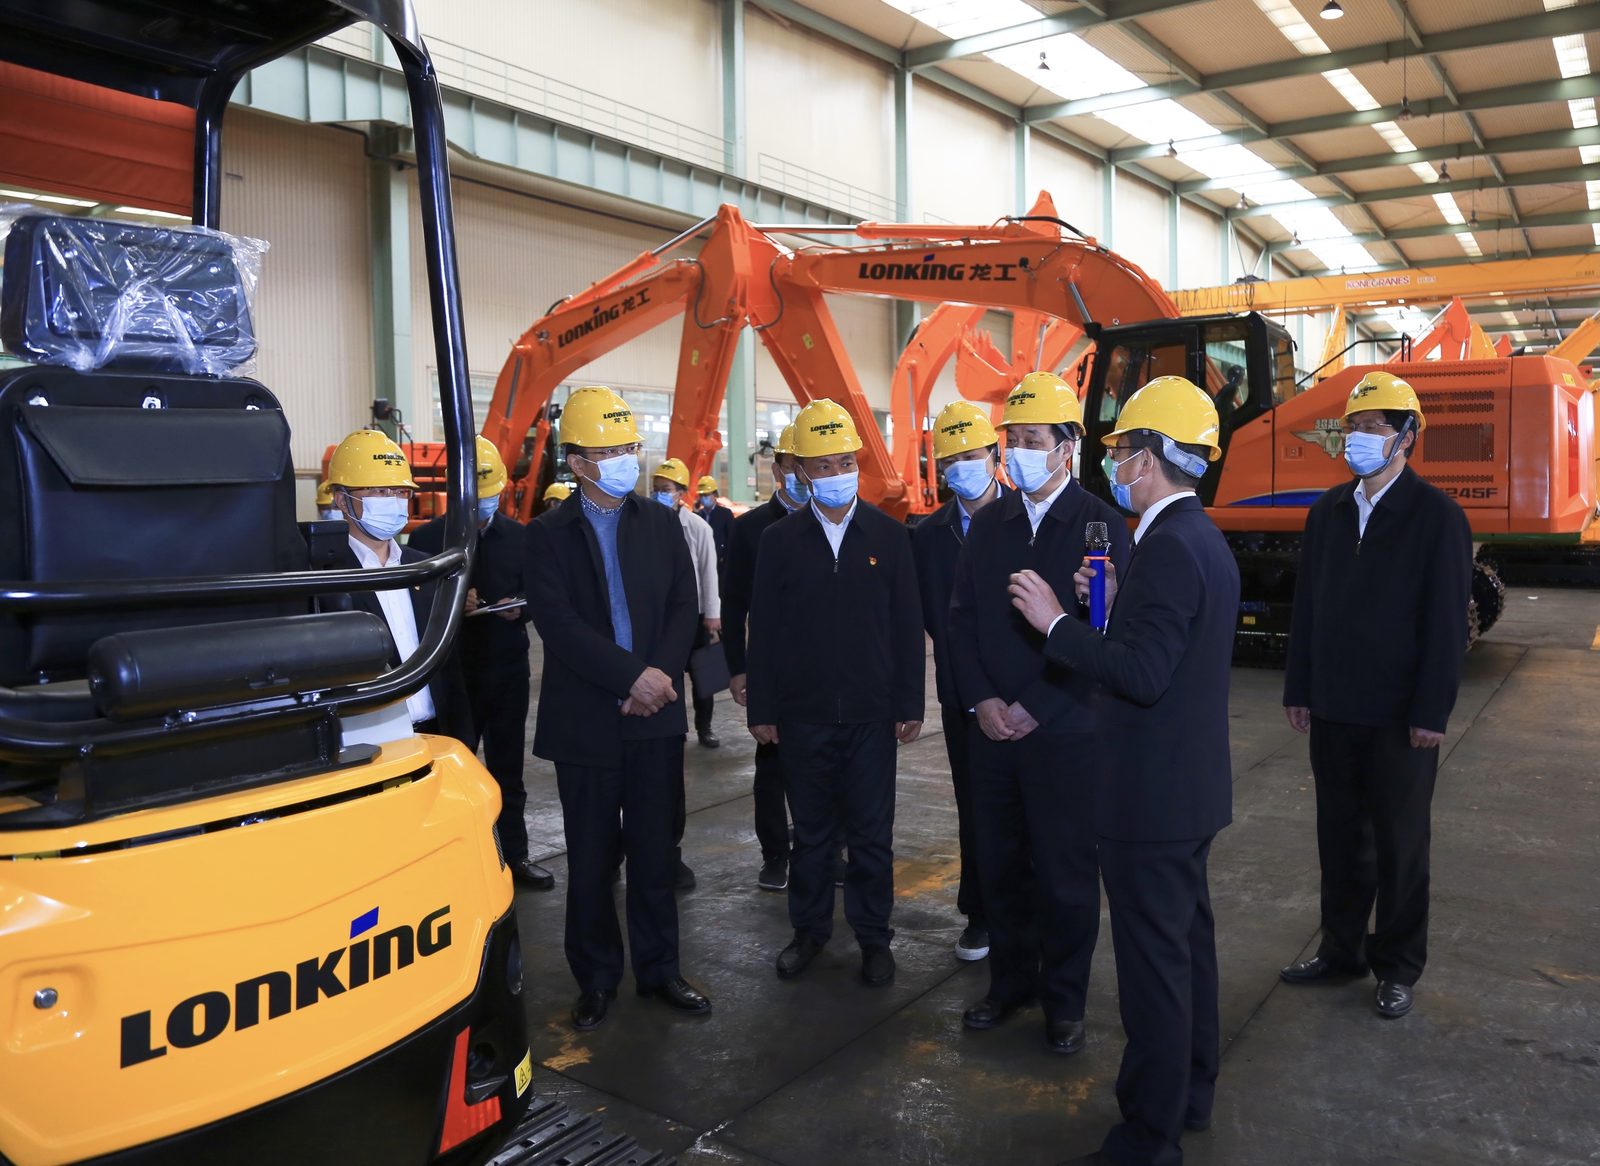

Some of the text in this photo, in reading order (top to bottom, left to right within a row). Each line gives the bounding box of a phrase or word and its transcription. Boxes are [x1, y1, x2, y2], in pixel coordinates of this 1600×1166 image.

[859, 254, 1017, 281] LONKING 龙工
[558, 305, 619, 348] LONKING
[1440, 487, 1498, 499] 245F
[120, 904, 452, 1069] LONKING
